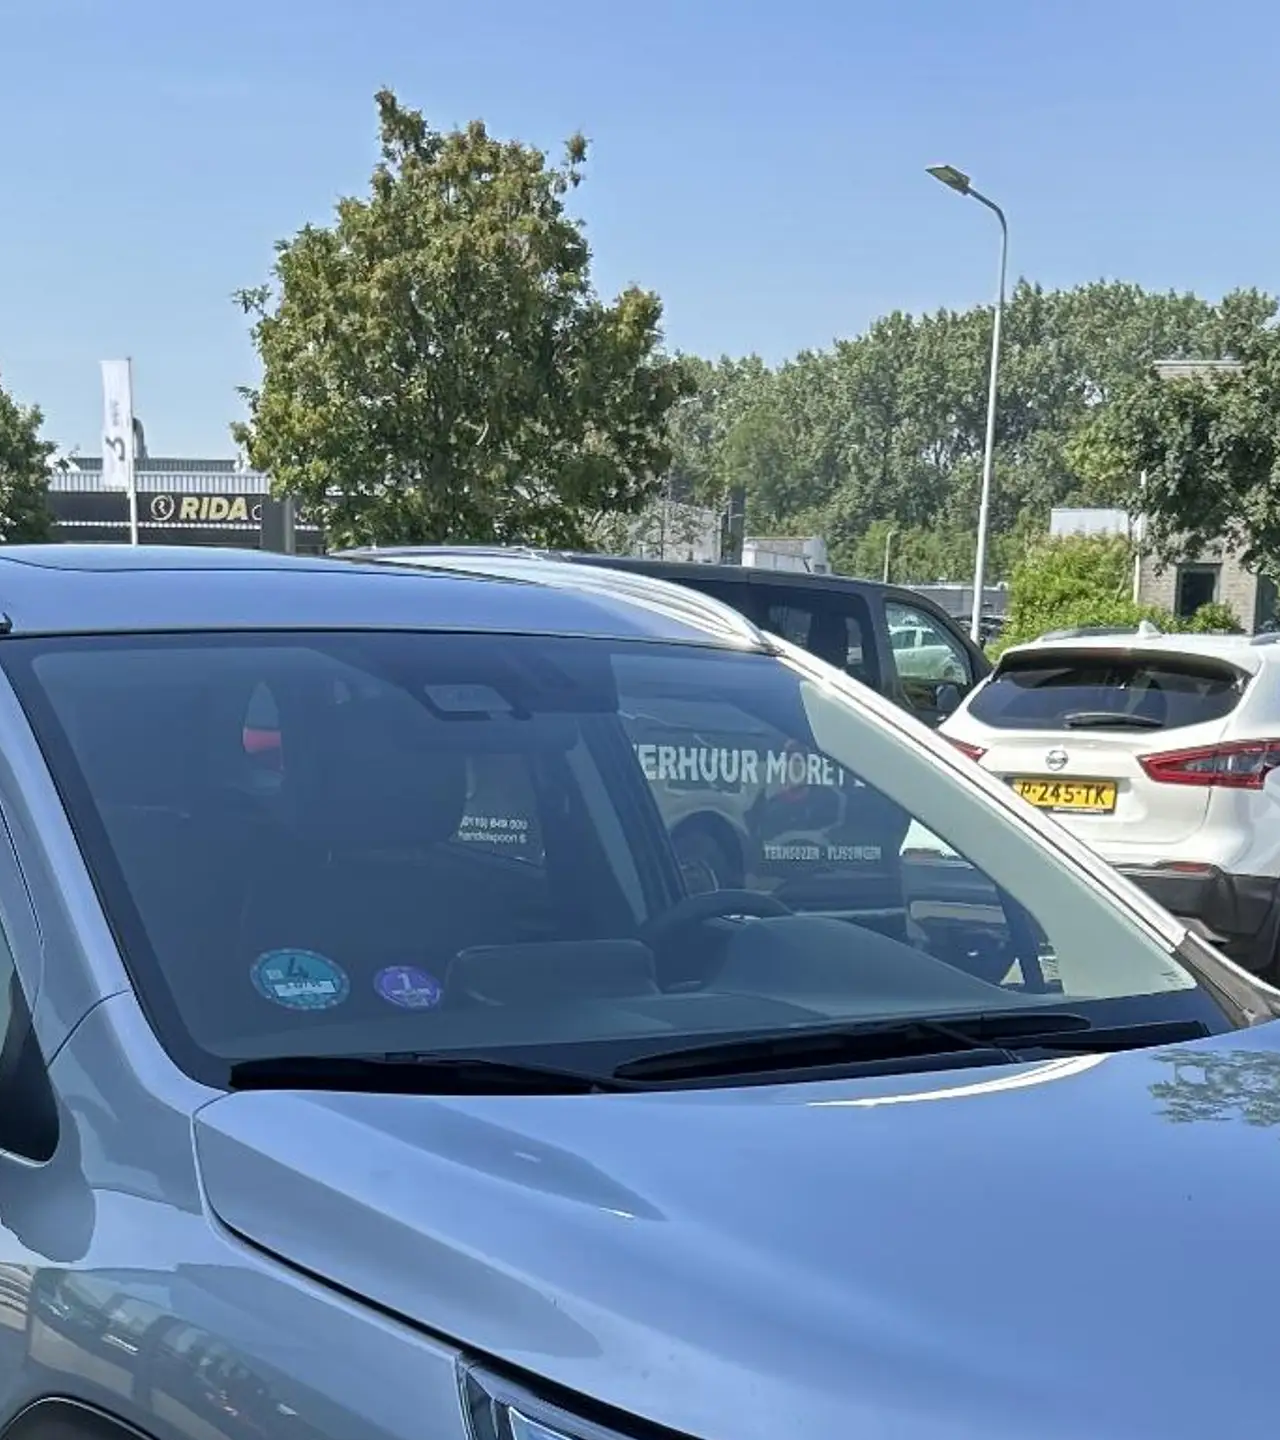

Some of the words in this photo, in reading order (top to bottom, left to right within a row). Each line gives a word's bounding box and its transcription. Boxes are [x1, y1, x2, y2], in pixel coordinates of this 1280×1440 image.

[179, 497, 249, 520] RIDA
[633, 744, 758, 784] ERHUUR
[1020, 782, 1106, 805] P-245-TK
